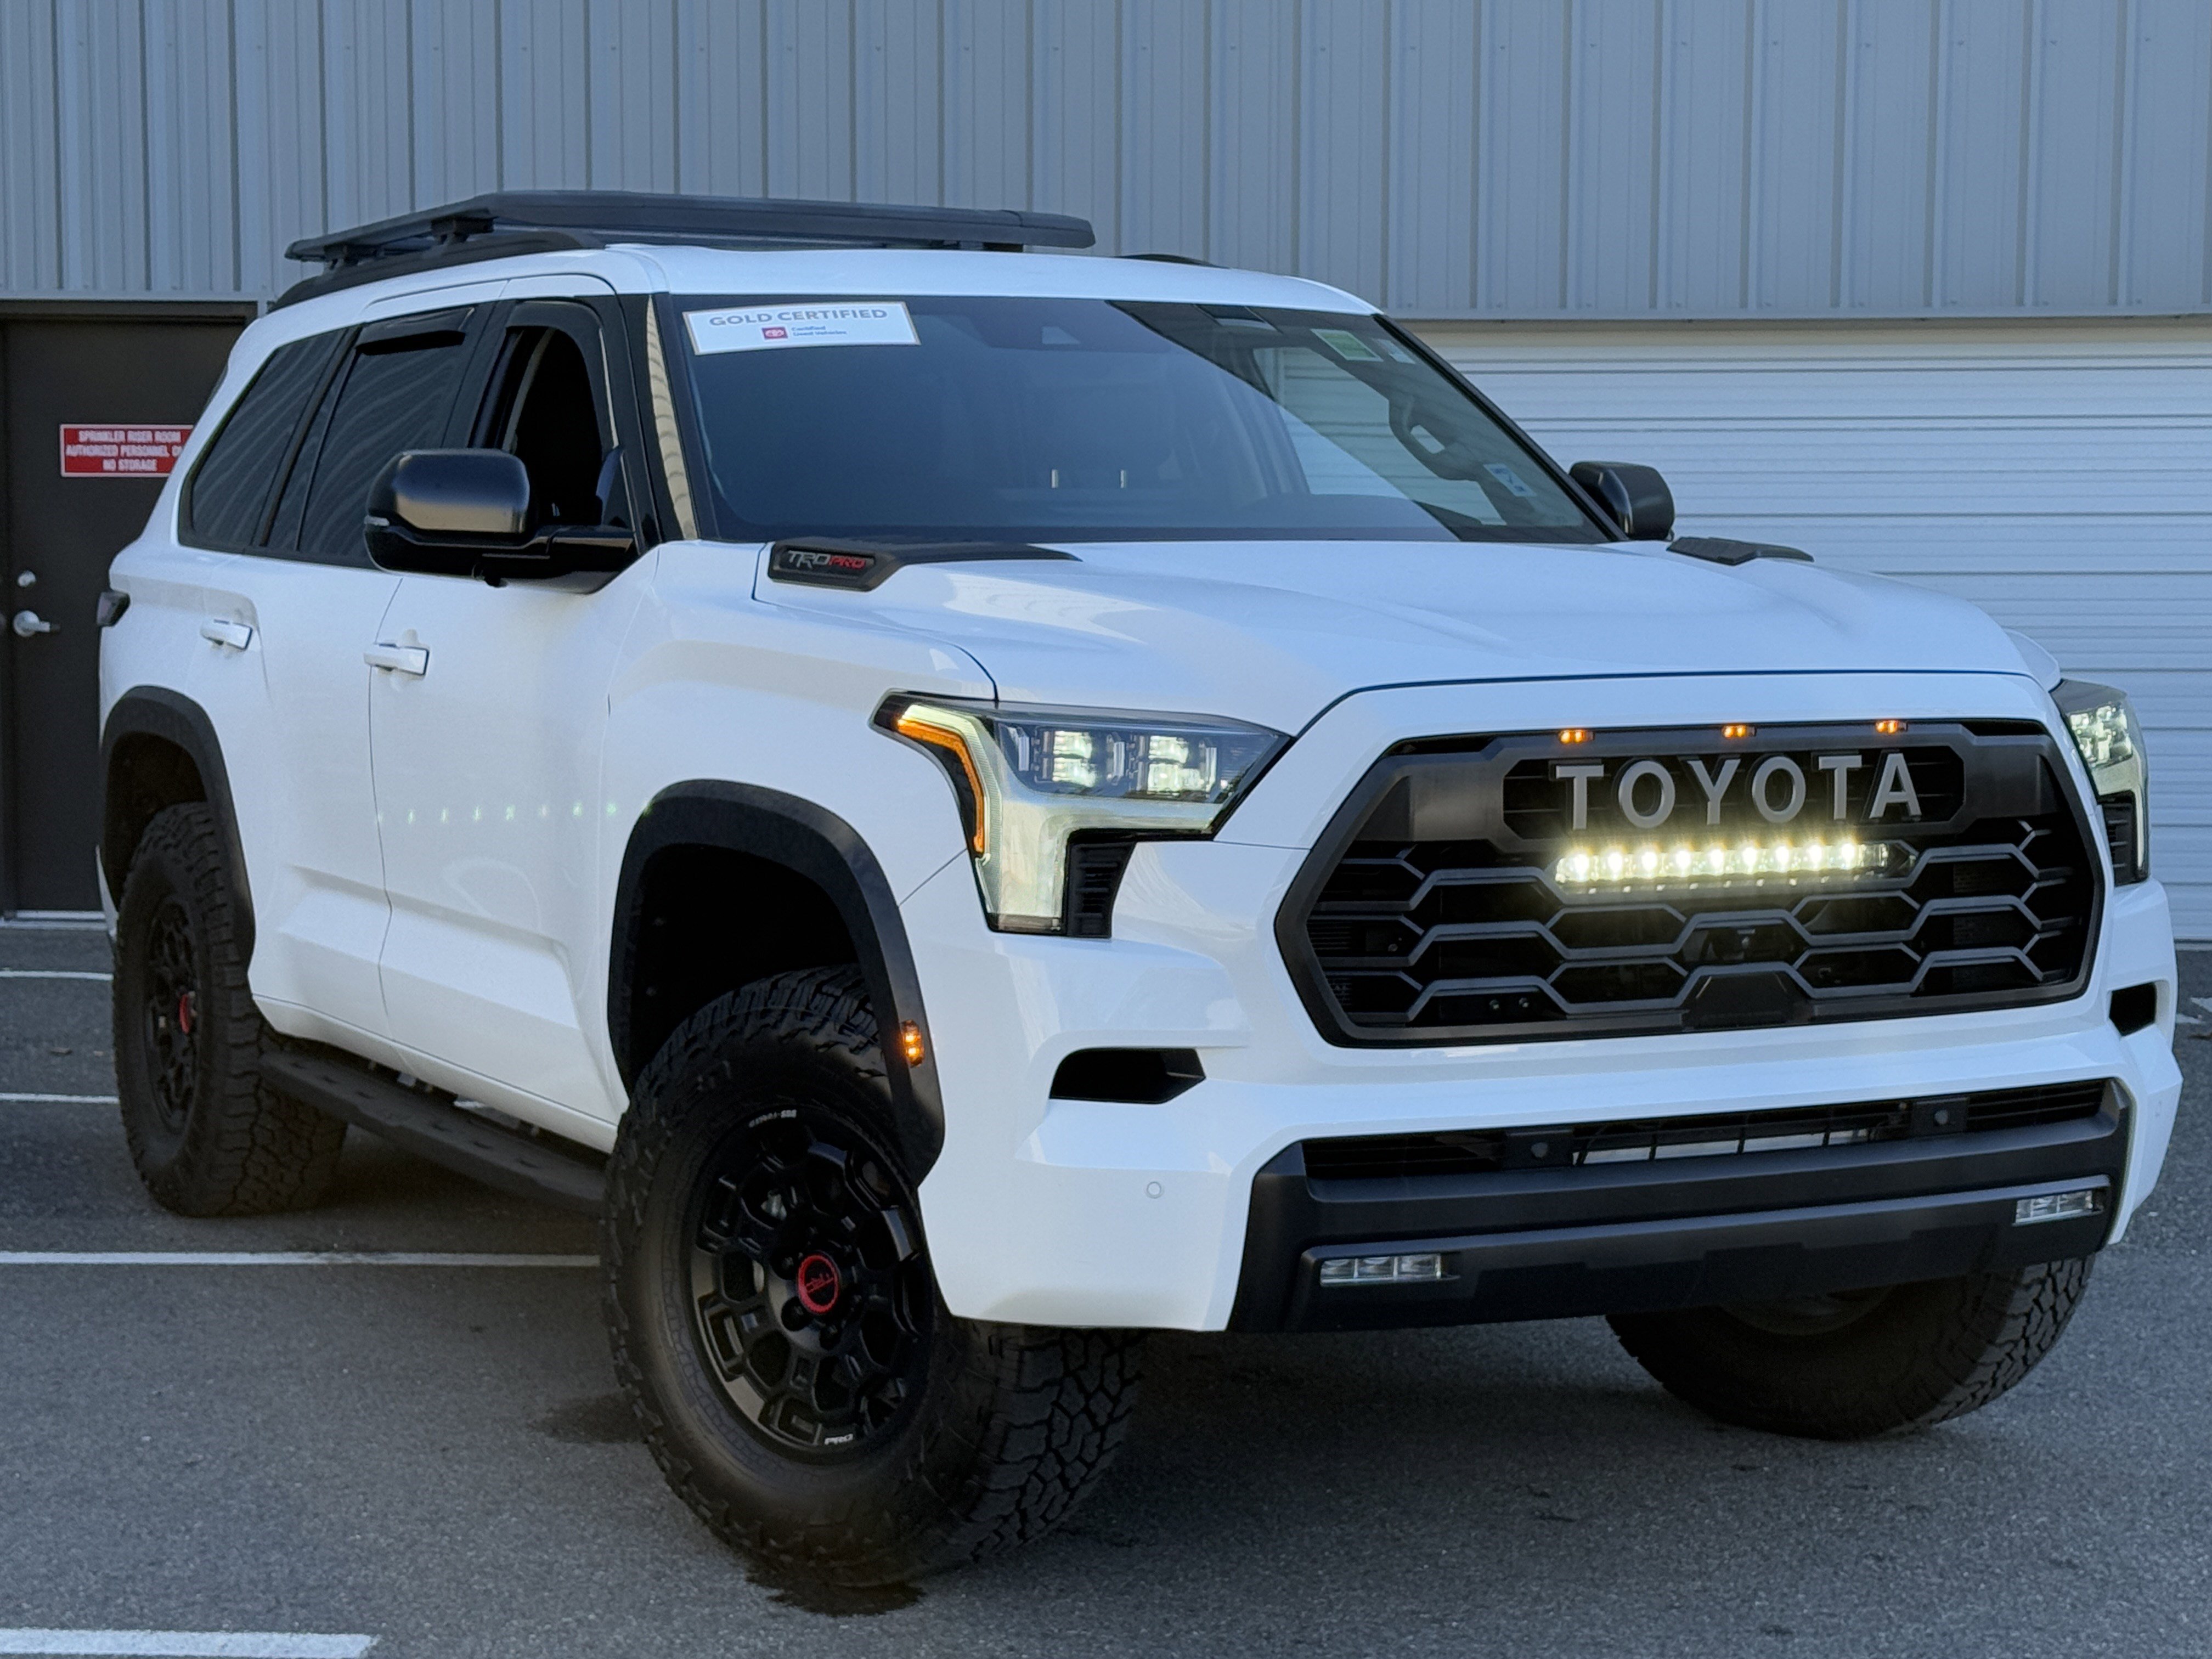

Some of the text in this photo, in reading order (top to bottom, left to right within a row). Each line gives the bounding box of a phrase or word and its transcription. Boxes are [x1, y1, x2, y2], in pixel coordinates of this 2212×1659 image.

[709, 309, 888, 326] GOLD CERTIFIED
[1555, 753, 1922, 830] TOYOTA
[824, 1434, 854, 1445] PRO
